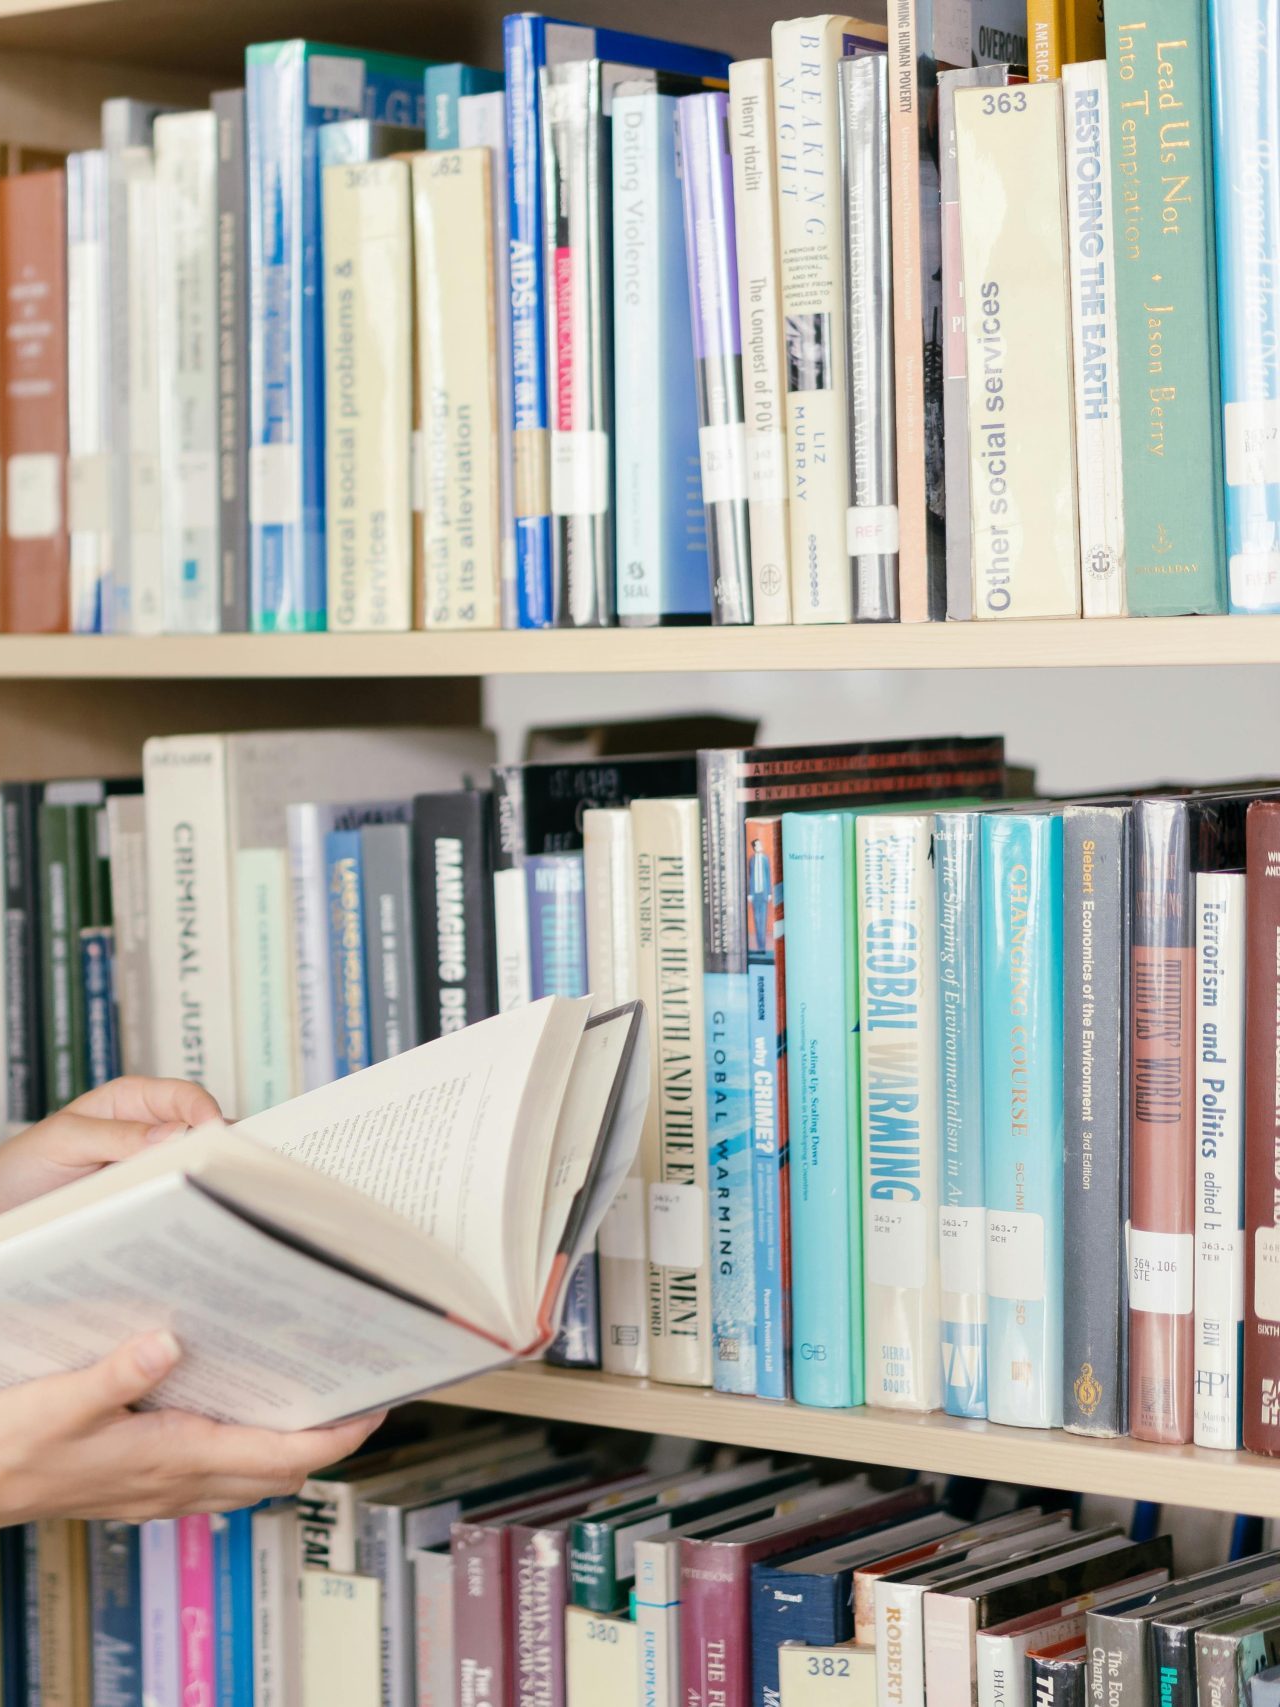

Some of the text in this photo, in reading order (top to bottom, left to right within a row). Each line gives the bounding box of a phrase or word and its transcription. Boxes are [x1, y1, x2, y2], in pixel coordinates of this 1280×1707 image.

[898, 31, 910, 67] HUMAN
[1033, 23, 1049, 84] AMERICA
[899, 71, 912, 114] POVERTY
[982, 90, 1027, 116] 363
[739, 95, 763, 192] Henry Hazlitt
[777, 72, 799, 202] NIGHT
[799, 34, 825, 236] BREAKING
[1117, 21, 1150, 262] Into Temptation
[1156, 39, 1192, 236] Lead Us Not
[620, 110, 645, 306] Dating Violence
[850, 184, 864, 229] WHY
[1232, 139, 1277, 266] Beyond
[789, 246, 815, 255] MEMOIR
[792, 273, 806, 281] AND
[812, 280, 833, 288] FROM
[851, 233, 867, 328] PRESERVE
[1075, 88, 1108, 420] RESTORING THE EARTH
[749, 276, 767, 303] The
[748, 308, 769, 373] Conquest
[854, 330, 869, 414] NATURAL
[753, 380, 773, 396] of
[1143, 303, 1177, 457] Jason Berry
[333, 257, 359, 627] General social problems &
[794, 406, 808, 502] MURRAY
[813, 431, 826, 464] LIZ
[976, 281, 1011, 612] Other social services
[428, 386, 453, 623] Social pathology
[453, 403, 475, 623] & its alleviation
[855, 523, 884, 539] REF
[365, 510, 388, 626] services
[173, 822, 200, 983] CRIMINAL
[434, 837, 467, 983] MANAGING
[637, 853, 652, 948] GREENBERG
[864, 837, 890, 912] Schneider
[1202, 899, 1227, 1007] Terrorism
[658, 855, 694, 1155] PUBLIC HEALTH AND THE
[757, 975, 766, 1021] ROBINSON
[939, 855, 963, 1177] The Shaping of Environmentalism in
[1010, 863, 1029, 1138] CHANGING COURSE
[1081, 839, 1096, 1190] Siebert Economics of the Environment 3rd Edition
[753, 1036, 769, 1067] why
[866, 918, 921, 1202] GLOBAL WARMING
[1202, 1021, 1227, 1063] and
[754, 1069, 774, 1154] CRIME?
[808, 1038, 821, 1167] Scaling Up, Scaling Down
[1135, 1055, 1182, 1124] WORLD
[1202, 1077, 1228, 1159] Politics
[713, 1010, 733, 1276] GLOBAL WARMING
[874, 1214, 902, 1224] 363.7
[942, 1218, 969, 1228] 363.7
[990, 1223, 1019, 1234] 363.7
[1204, 1171, 1222, 1215] edited
[942, 1229, 958, 1238] SCH
[990, 1235, 1008, 1244] SCH
[1134, 1257, 1177, 1273] 364.106
[1133, 1268, 1151, 1282] STE
[762, 1288, 774, 1372] Pearson Prentice Hall
[1203, 1318, 1220, 1347] BIN
[1257, 1323, 1280, 1338] SIXTH
[320, 1577, 357, 1600] 378
[586, 1621, 619, 1644] 380
[707, 1638, 726, 1683] THE
[807, 1656, 851, 1677] 382
[885, 1606, 903, 1705] ROBERT
[1108, 1650, 1123, 1677] The
[1090, 1647, 1106, 1699] Change
